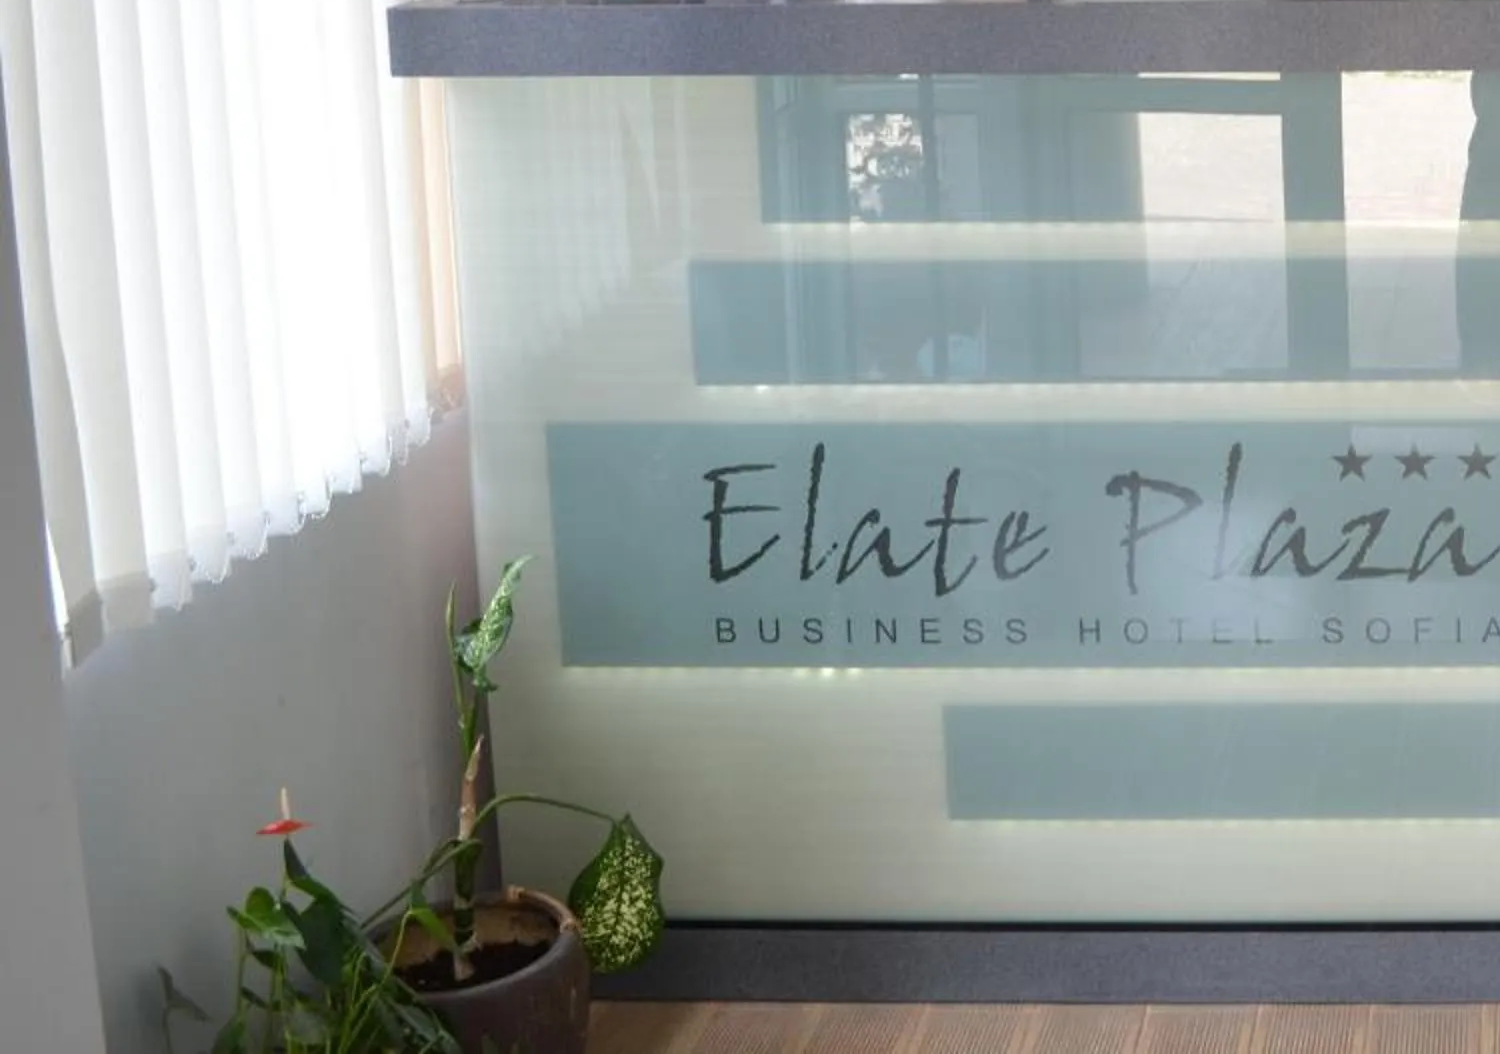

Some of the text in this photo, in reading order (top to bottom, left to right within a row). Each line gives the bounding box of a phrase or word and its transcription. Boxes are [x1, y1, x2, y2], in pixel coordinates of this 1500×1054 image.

[702, 442, 1050, 597] Elate
[714, 617, 1029, 644] BUSINESS
[1078, 617, 1275, 645] HOTEL
